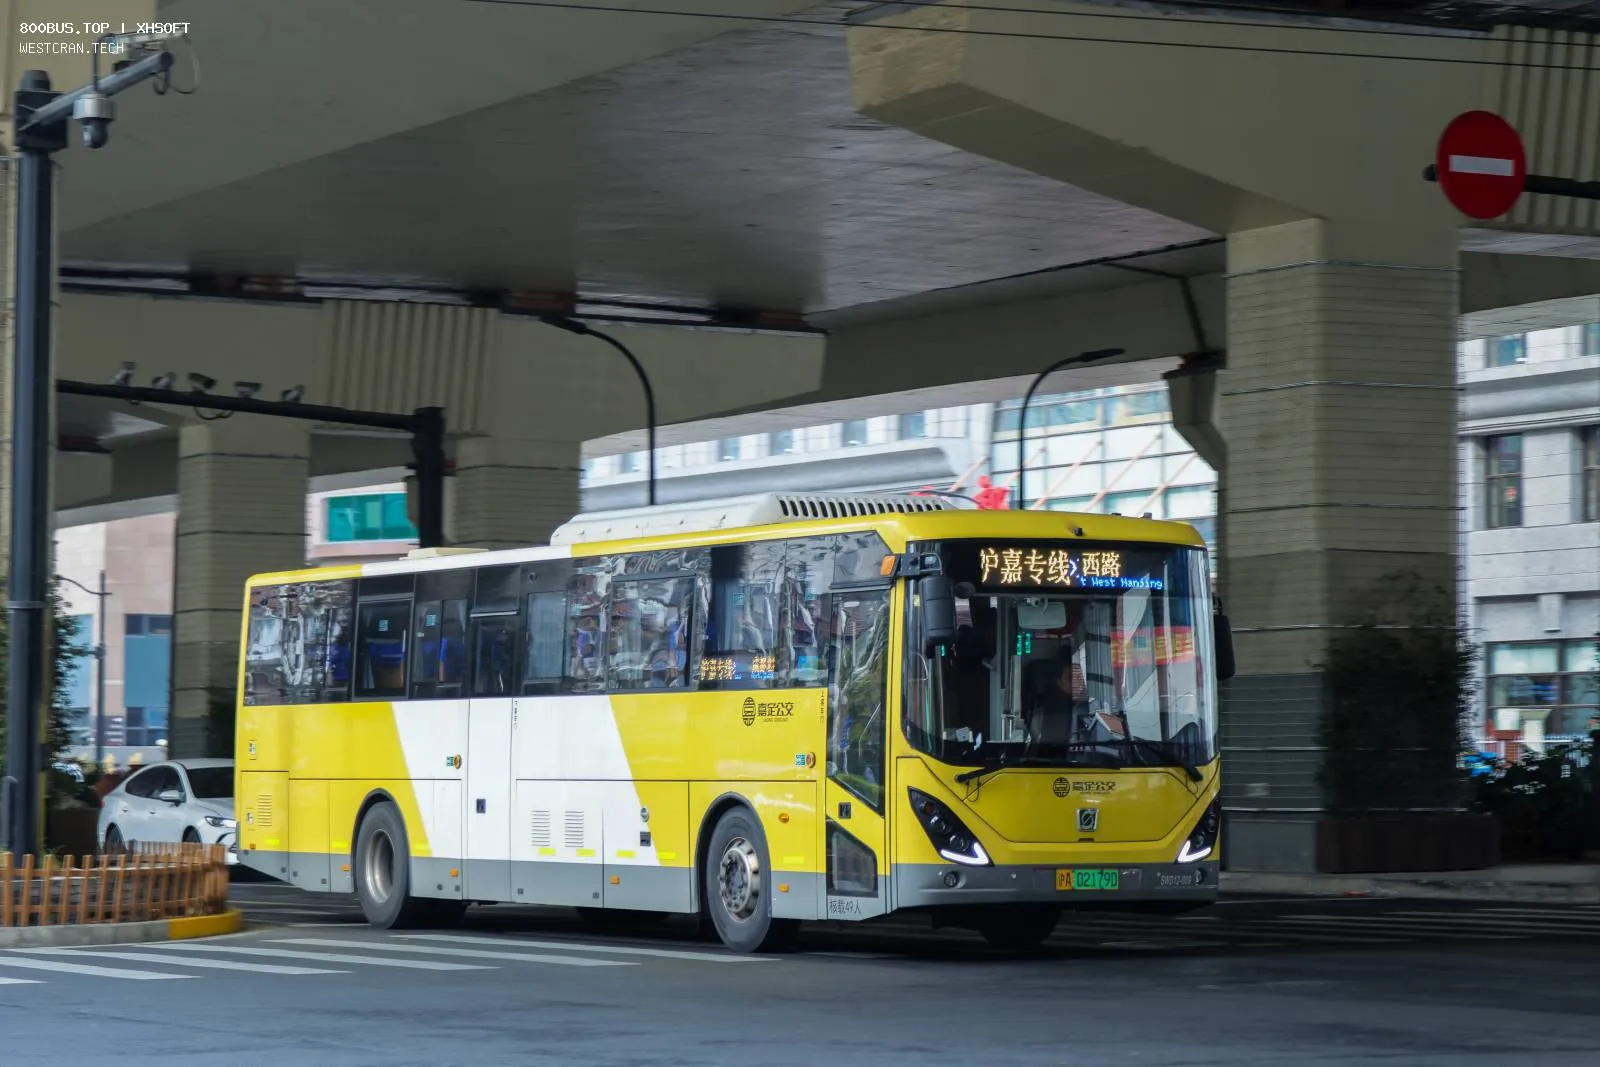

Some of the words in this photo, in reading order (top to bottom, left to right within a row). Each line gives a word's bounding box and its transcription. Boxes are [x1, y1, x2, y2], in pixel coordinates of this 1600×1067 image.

[979, 547, 1071, 586] 沪嘉专线
[1082, 551, 1122, 578] 西路
[757, 702, 794, 717] 嘉定公交
[1072, 780, 1117, 792] 嘉定公交
